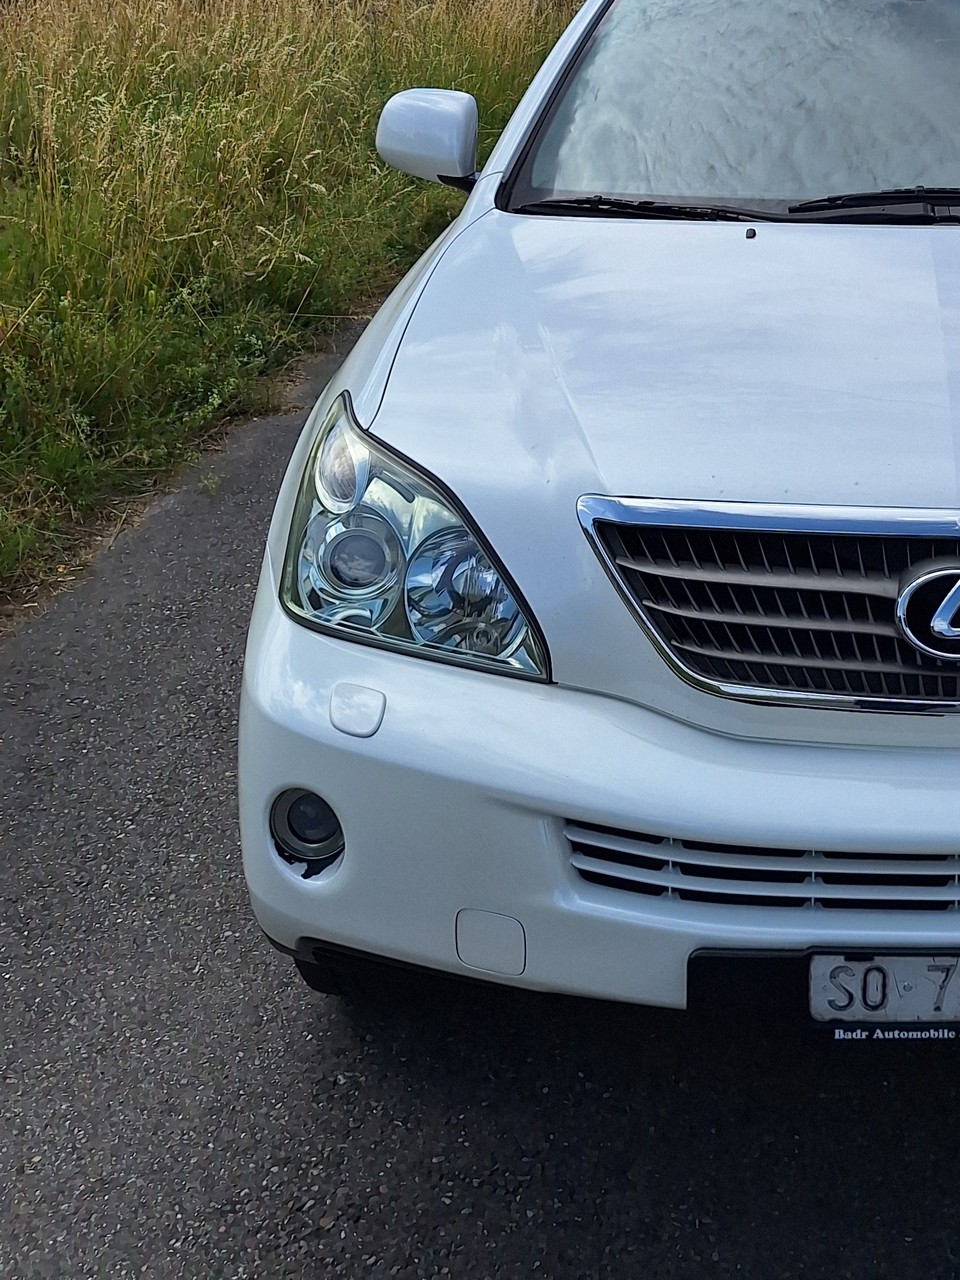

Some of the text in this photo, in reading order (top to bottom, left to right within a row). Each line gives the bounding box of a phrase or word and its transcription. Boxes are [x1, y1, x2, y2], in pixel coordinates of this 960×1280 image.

[827, 965, 888, 1012] SO
[834, 1029, 869, 1040] Badr
[872, 1028, 956, 1039] Automobile
